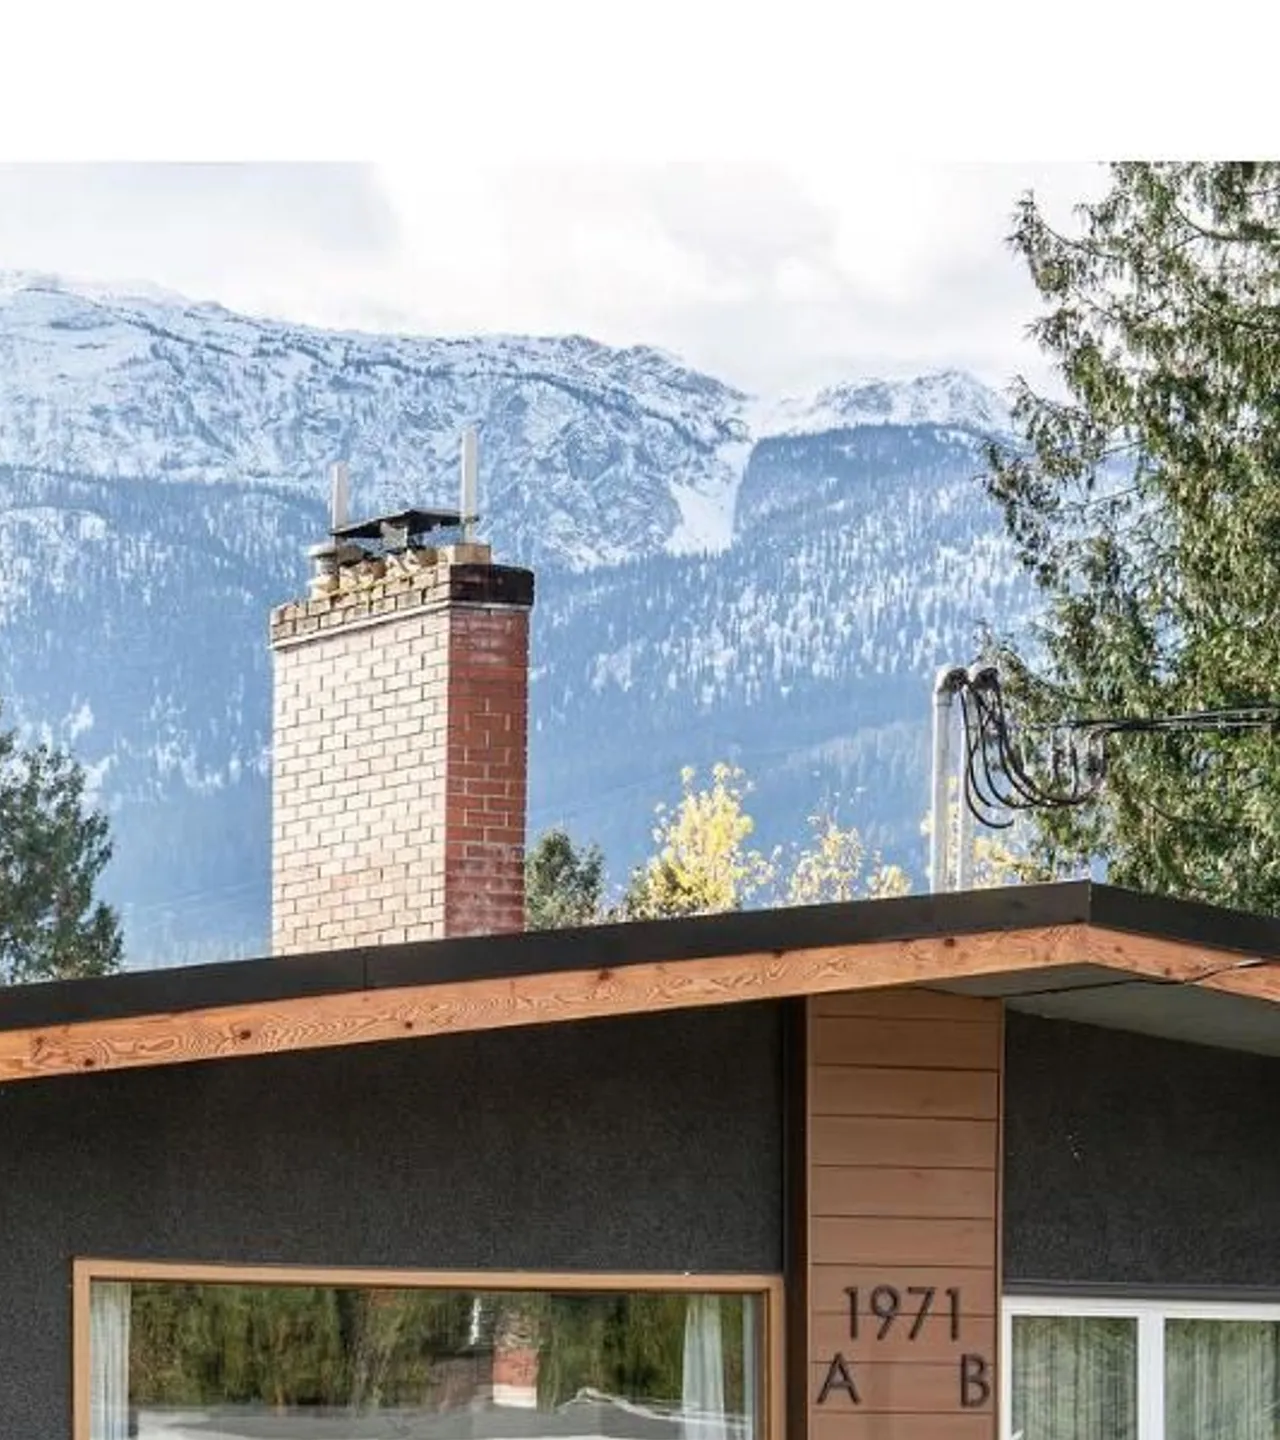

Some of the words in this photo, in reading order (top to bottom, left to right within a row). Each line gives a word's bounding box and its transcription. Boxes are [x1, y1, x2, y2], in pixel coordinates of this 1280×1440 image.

[842, 1284, 962, 1341] 1971
[815, 1352, 861, 1406] A
[959, 1352, 990, 1409] B
